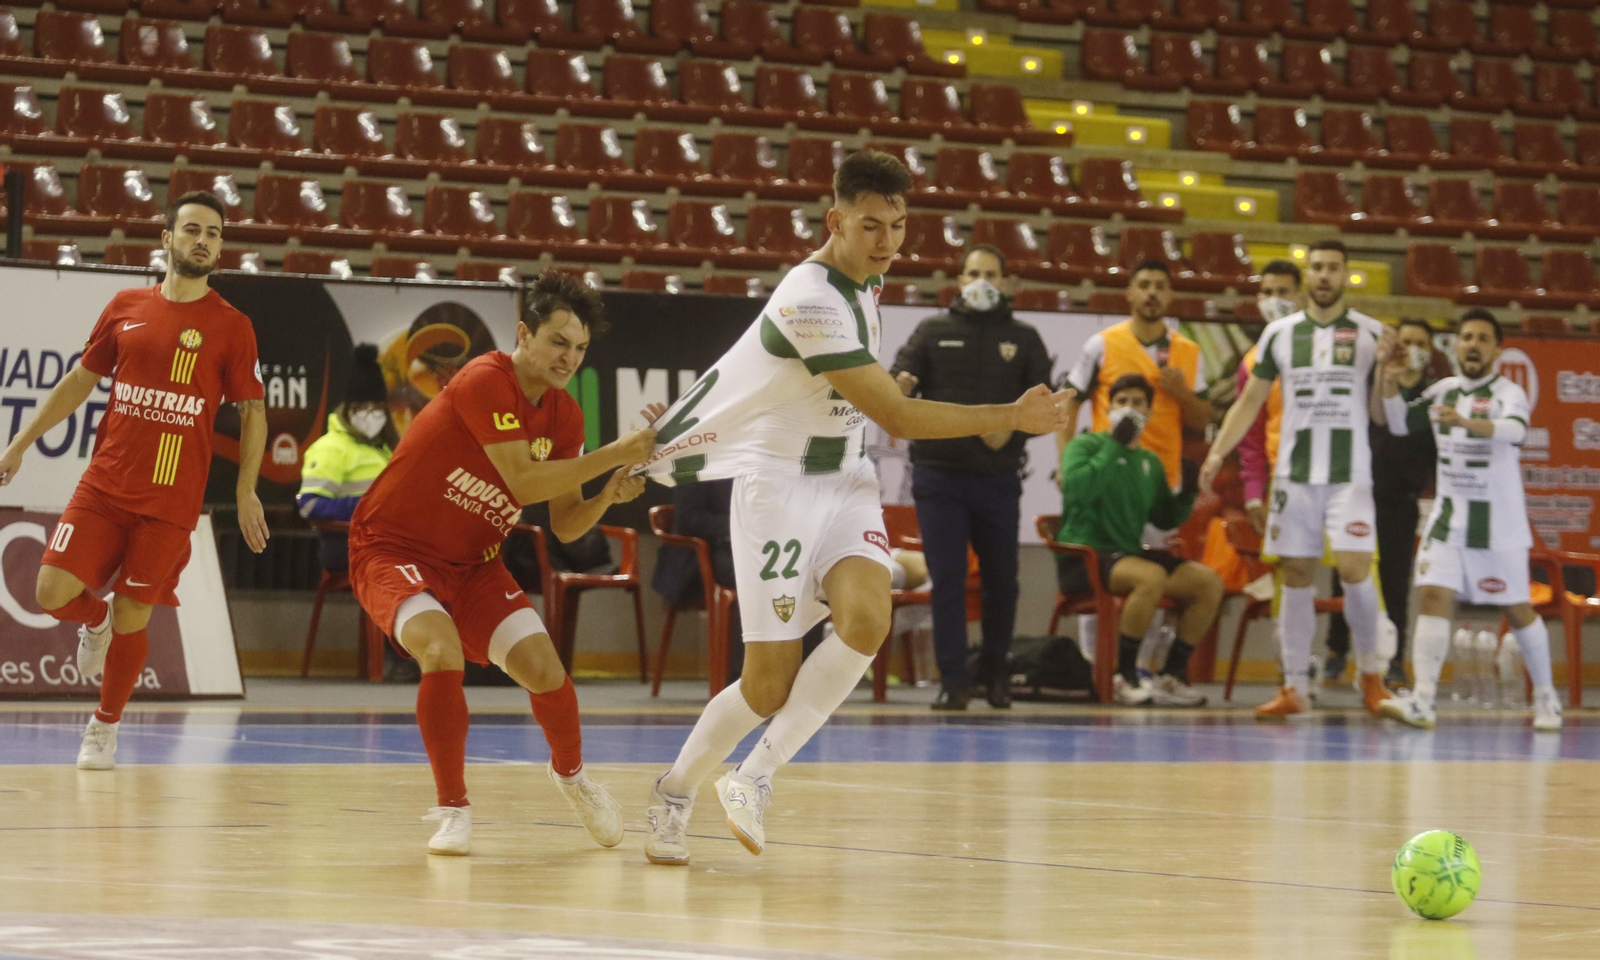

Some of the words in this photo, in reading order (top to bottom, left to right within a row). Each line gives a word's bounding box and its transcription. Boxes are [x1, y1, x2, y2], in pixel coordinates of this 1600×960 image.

[795, 318, 843, 326] IMDECO
[260, 364, 307, 376] ERIA
[115, 381, 206, 416] INDUSTRIAS
[114, 401, 141, 418] SANTA
[143, 408, 195, 427] COLOMA
[444, 487, 483, 515] SANTA
[49, 522, 75, 553] 10
[759, 538, 802, 581] 22
[394, 563, 424, 585] 17
[0, 661, 35, 684] es
